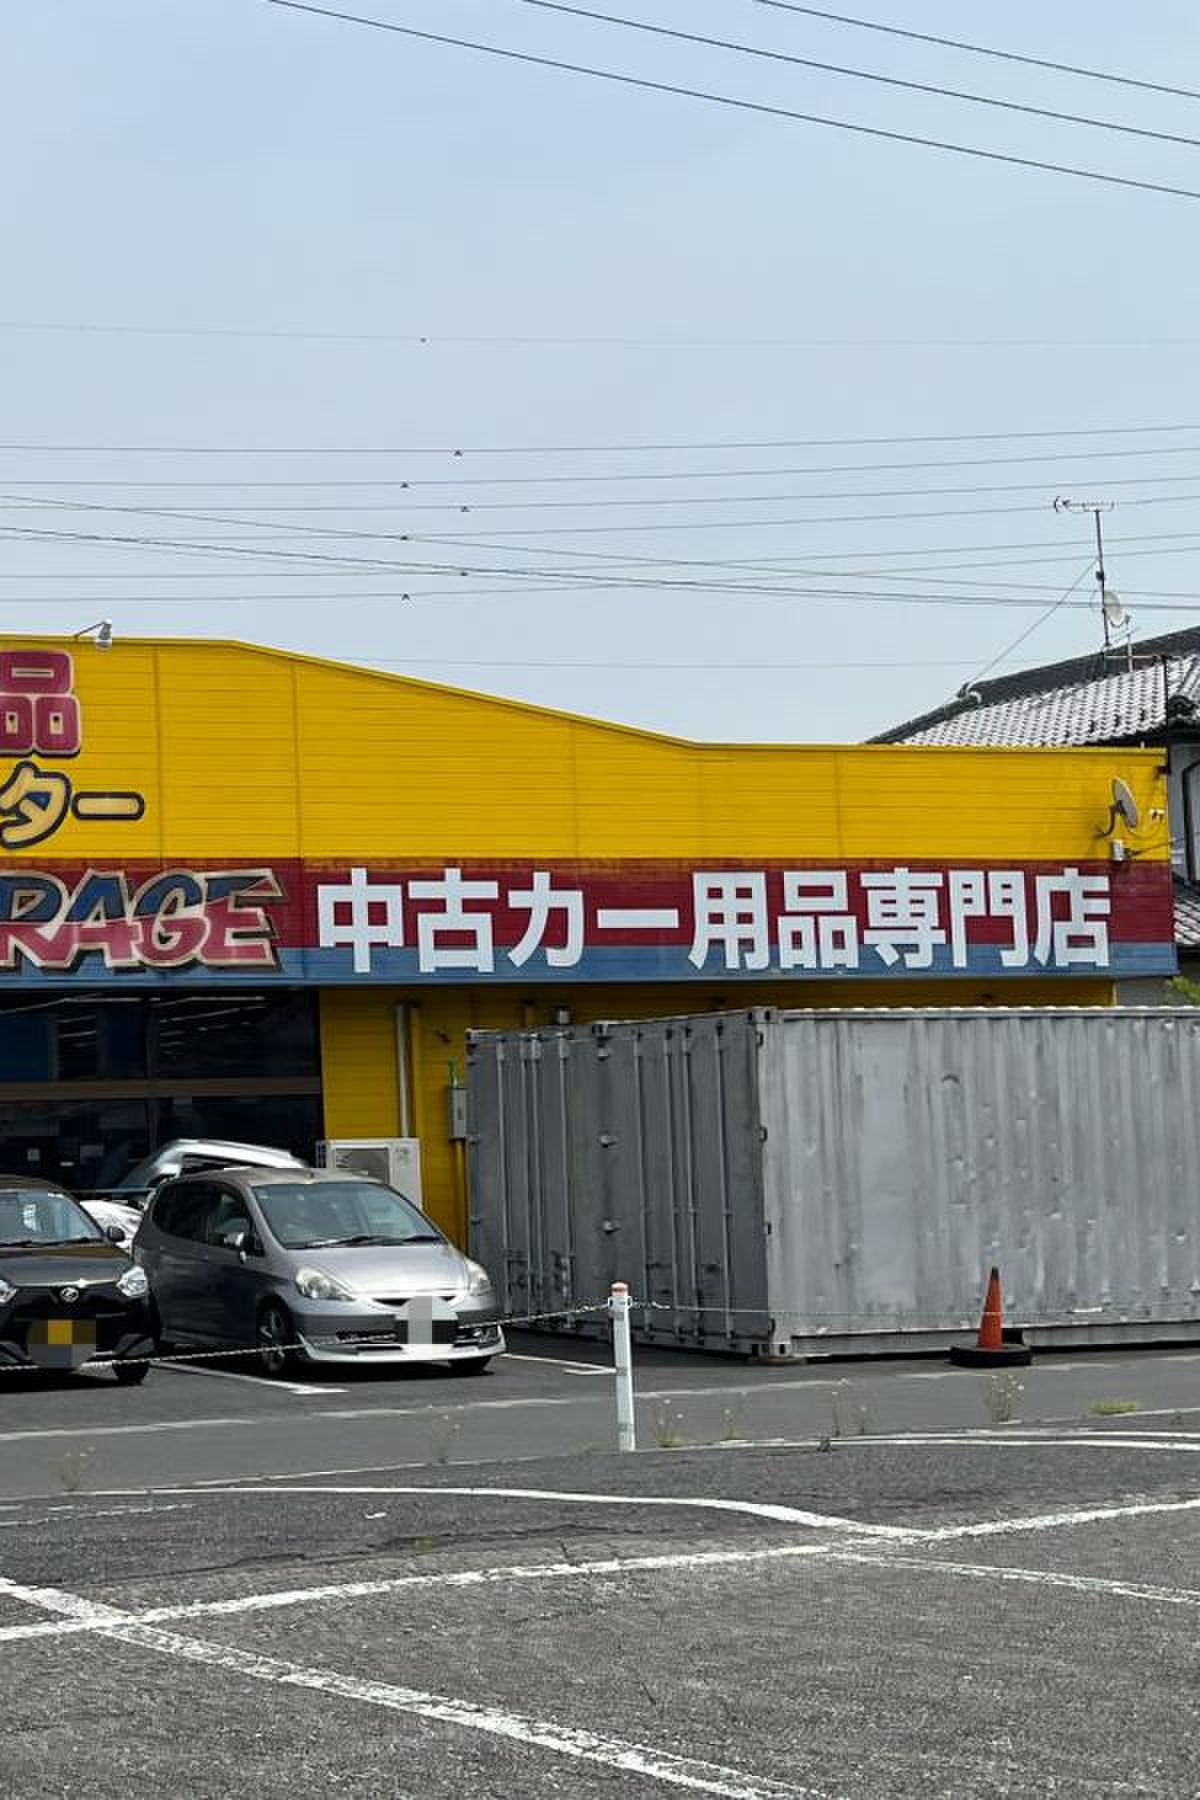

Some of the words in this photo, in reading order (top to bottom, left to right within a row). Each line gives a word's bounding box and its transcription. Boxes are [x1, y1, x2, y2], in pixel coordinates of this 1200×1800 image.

[317, 866, 1112, 974] 中古カー用品専門店
